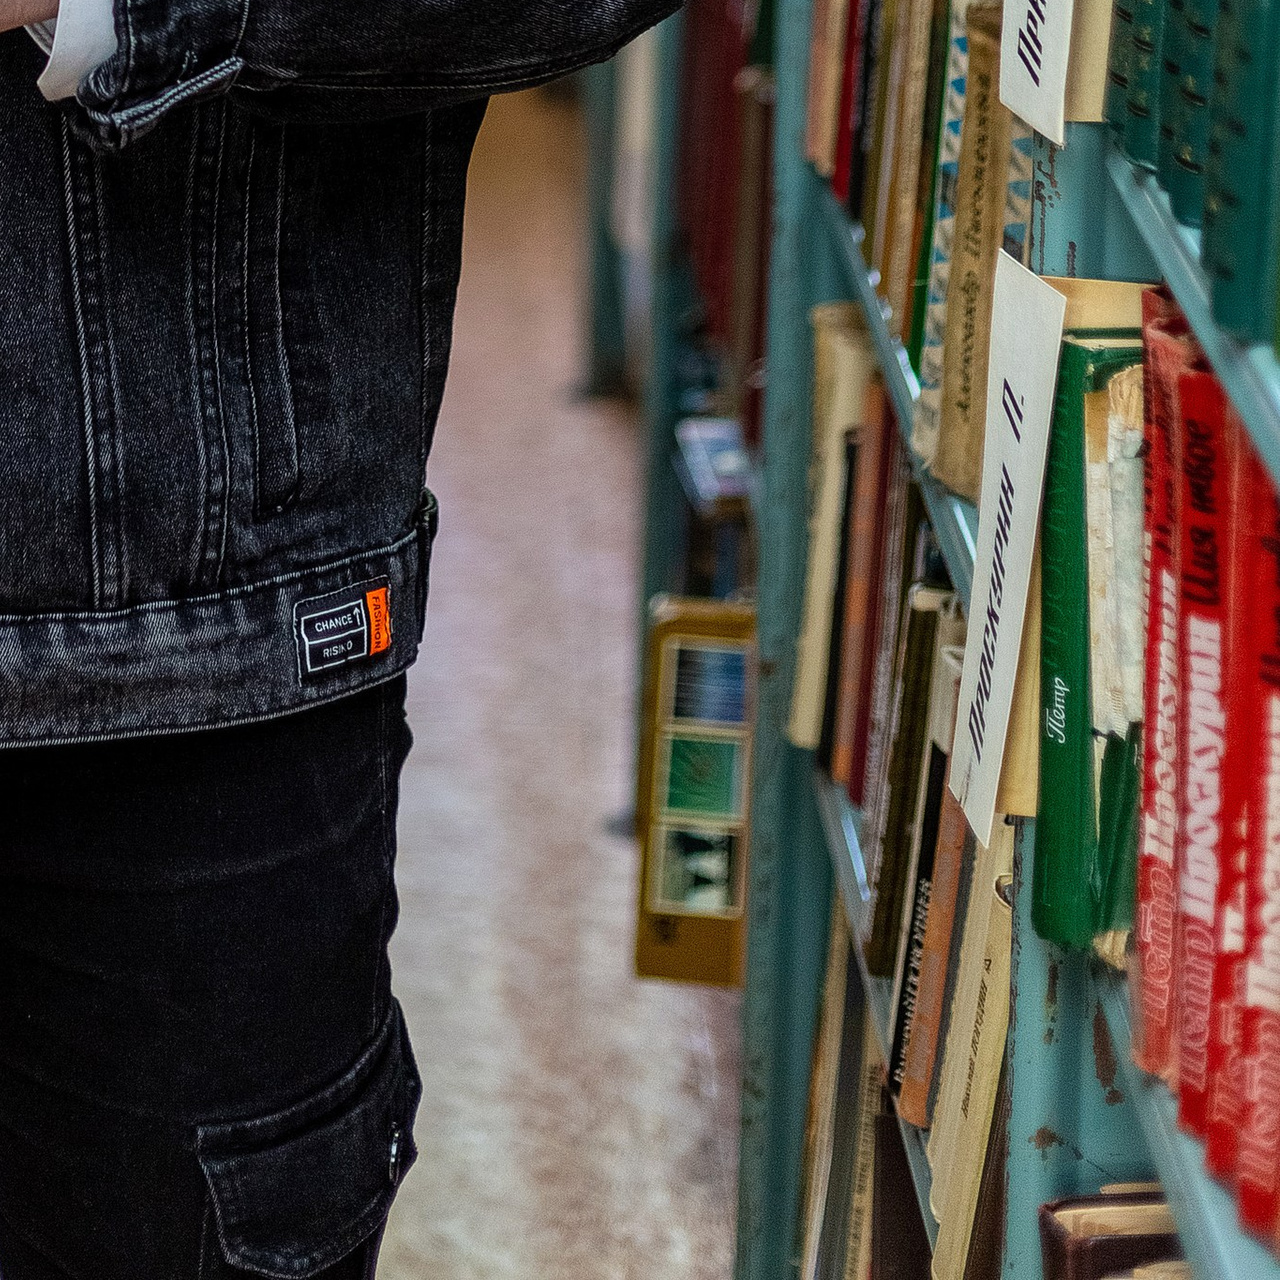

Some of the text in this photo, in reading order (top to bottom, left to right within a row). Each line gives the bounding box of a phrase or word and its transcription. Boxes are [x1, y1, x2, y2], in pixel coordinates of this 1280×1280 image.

[1002, 378, 1025, 444] П.
[314, 613, 354, 632] CHANCE
[372, 596, 381, 649] FASHION
[1046, 676, 1070, 743] Петр
[1143, 569, 1178, 866] Проскурин
[1178, 613, 1228, 924] Проскурин
